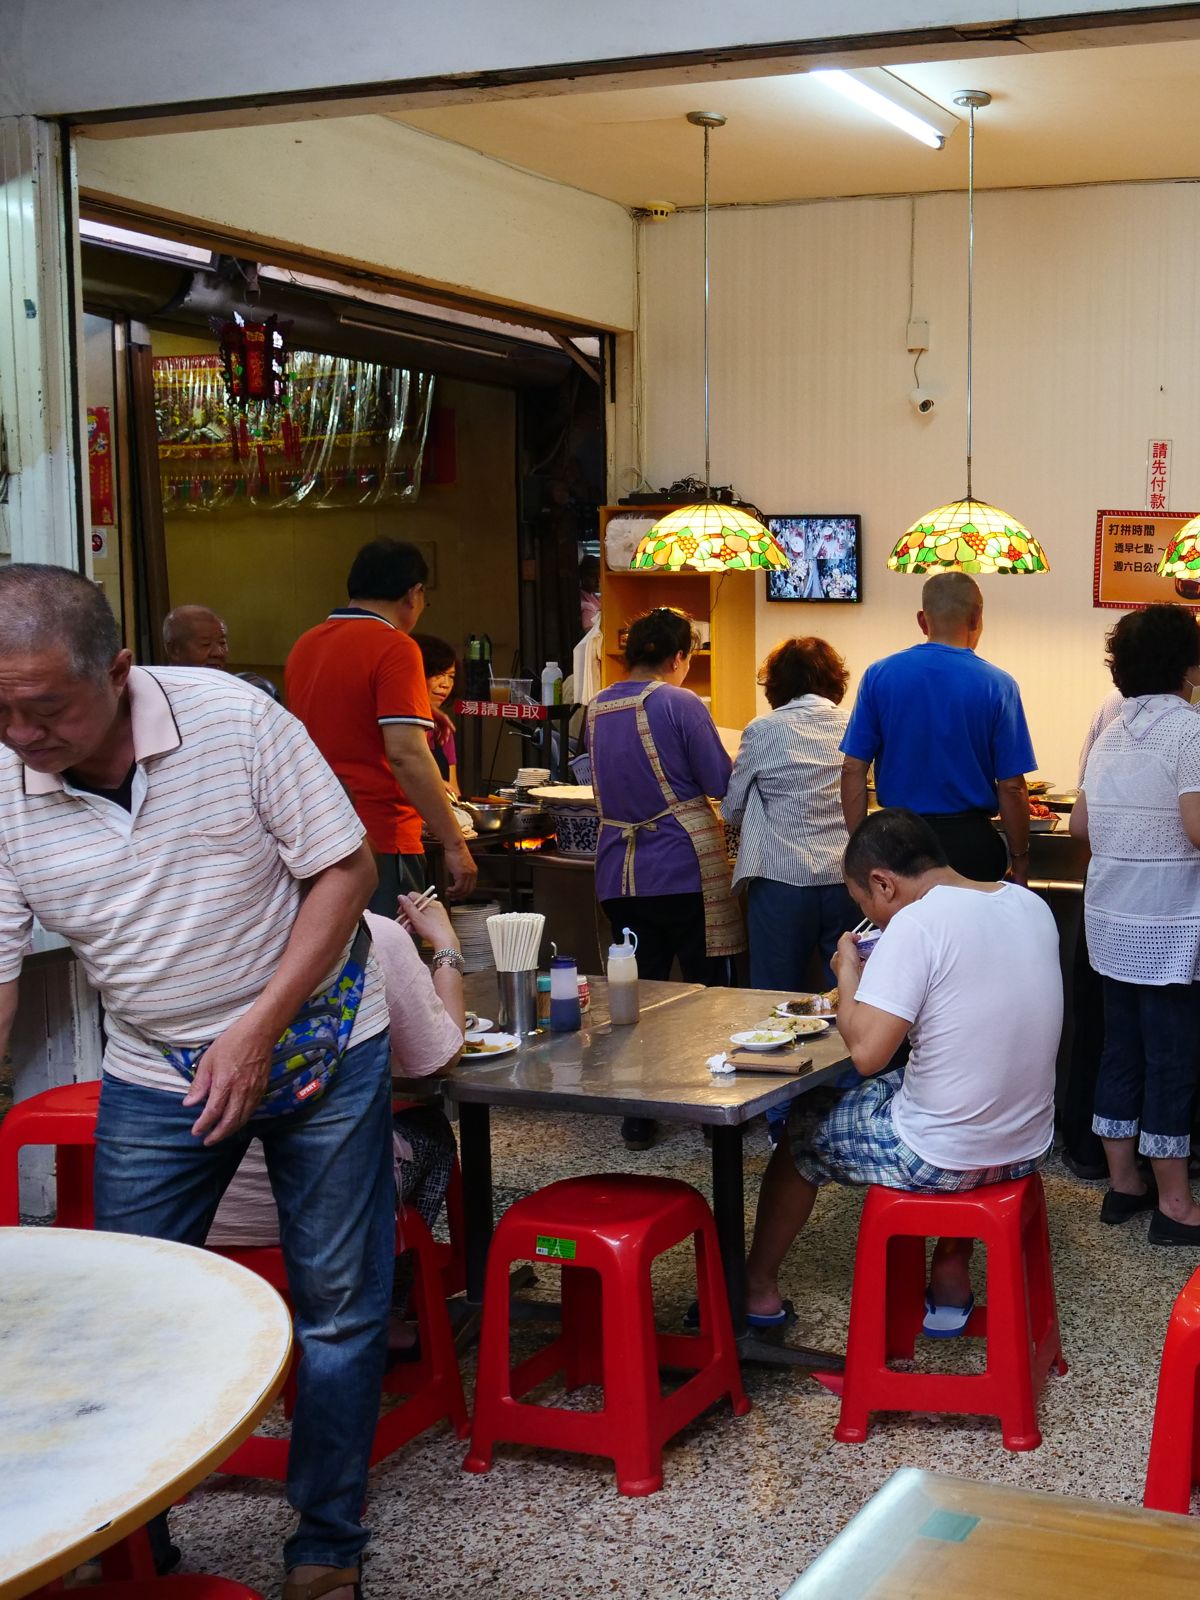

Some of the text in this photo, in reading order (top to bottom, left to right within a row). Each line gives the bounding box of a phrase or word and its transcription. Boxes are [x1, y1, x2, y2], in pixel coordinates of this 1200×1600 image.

[1150, 442, 1168, 510] 請先付款
[460, 701, 540, 719] 湯請自取
